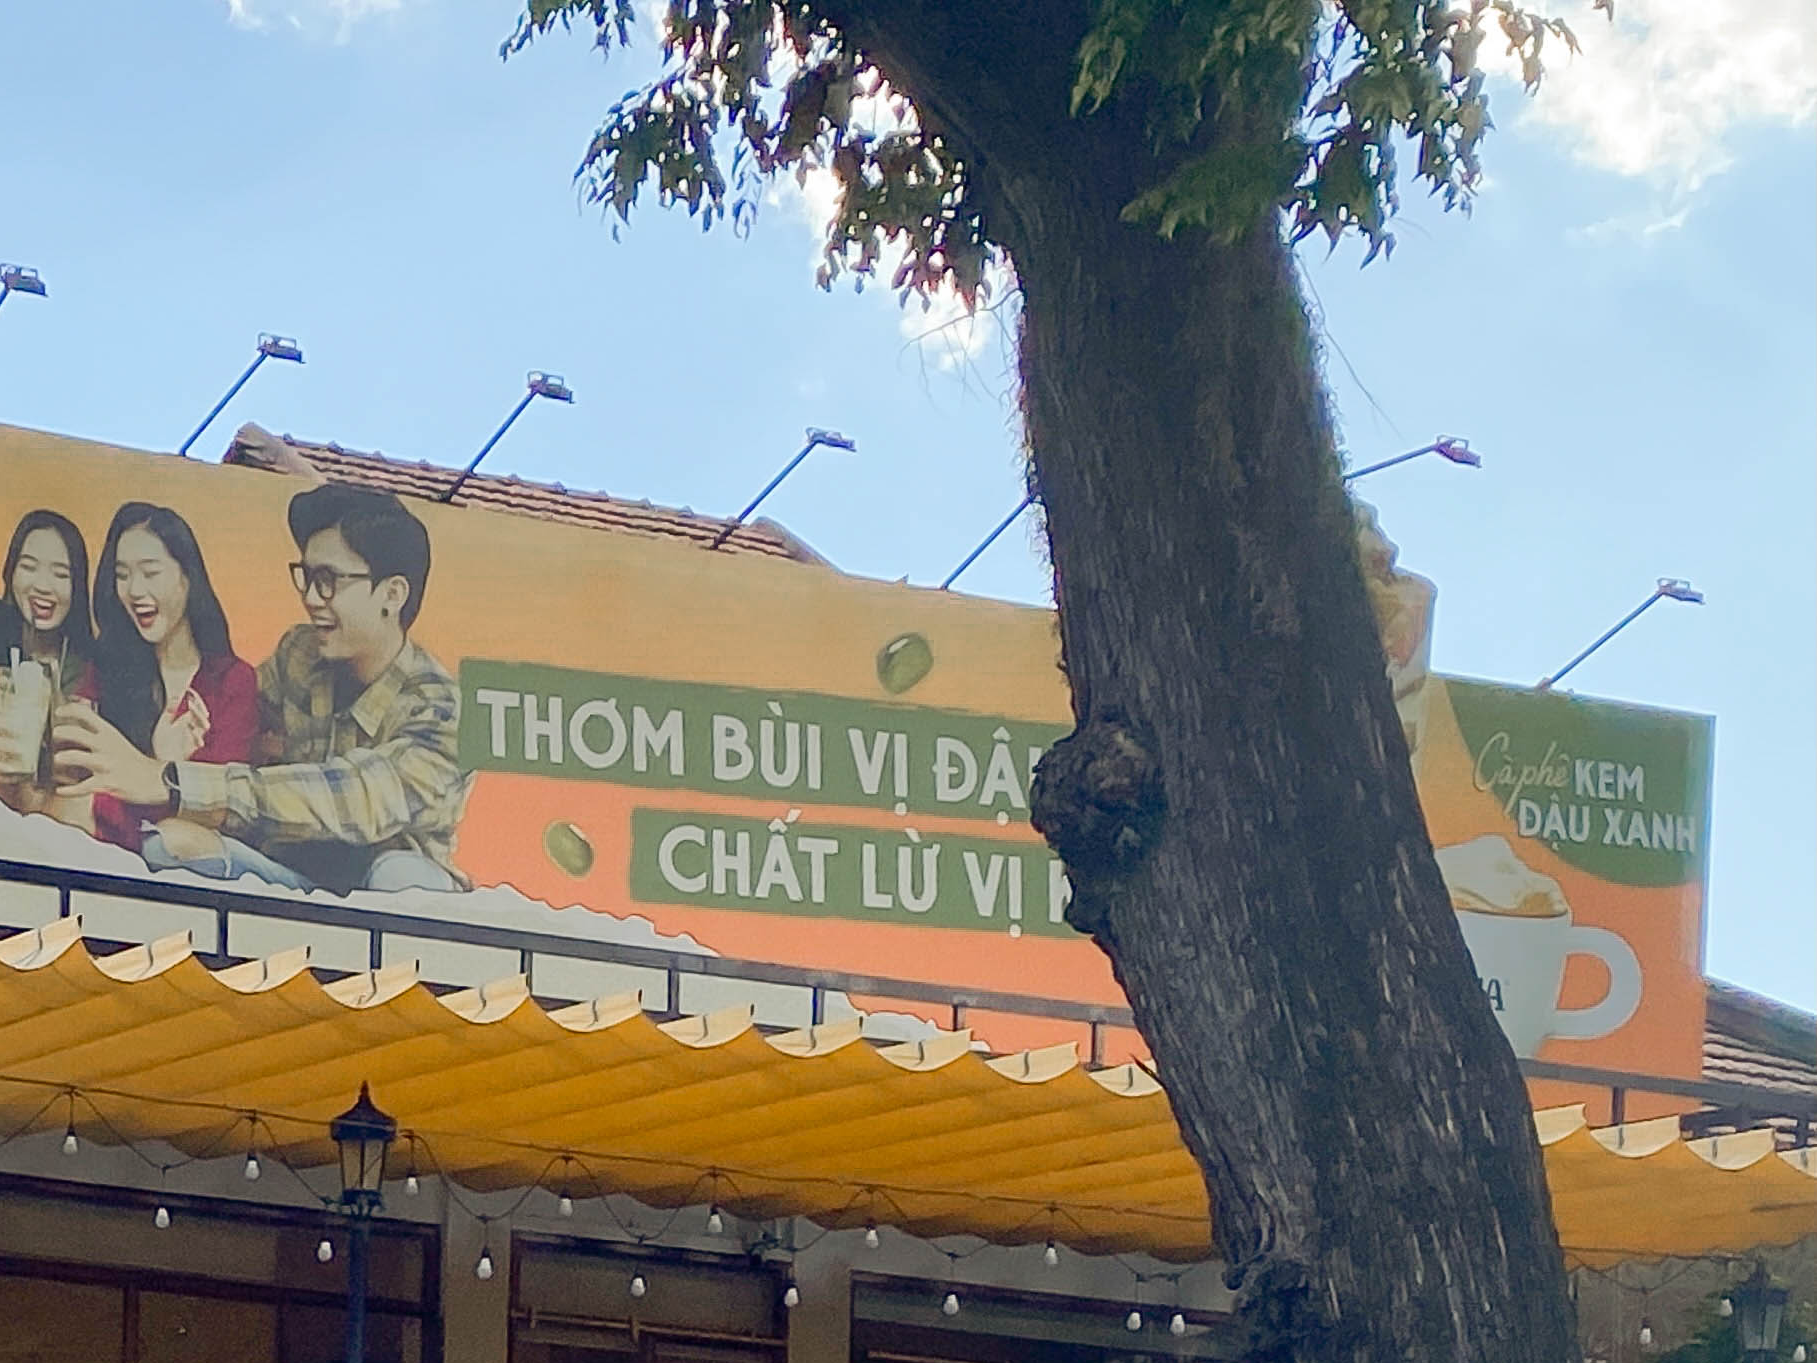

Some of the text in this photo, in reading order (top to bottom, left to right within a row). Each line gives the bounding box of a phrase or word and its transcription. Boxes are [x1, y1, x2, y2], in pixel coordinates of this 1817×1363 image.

[477, 688, 1046, 826] THƠM BÙI VỊ ĐẬ
[1575, 758, 1645, 803] KEM
[1517, 792, 1697, 854] ĐẬU XANH
[658, 809, 838, 903] CHẤT
[862, 828, 941, 913] LỪ
[963, 851, 1023, 938] VỊ
